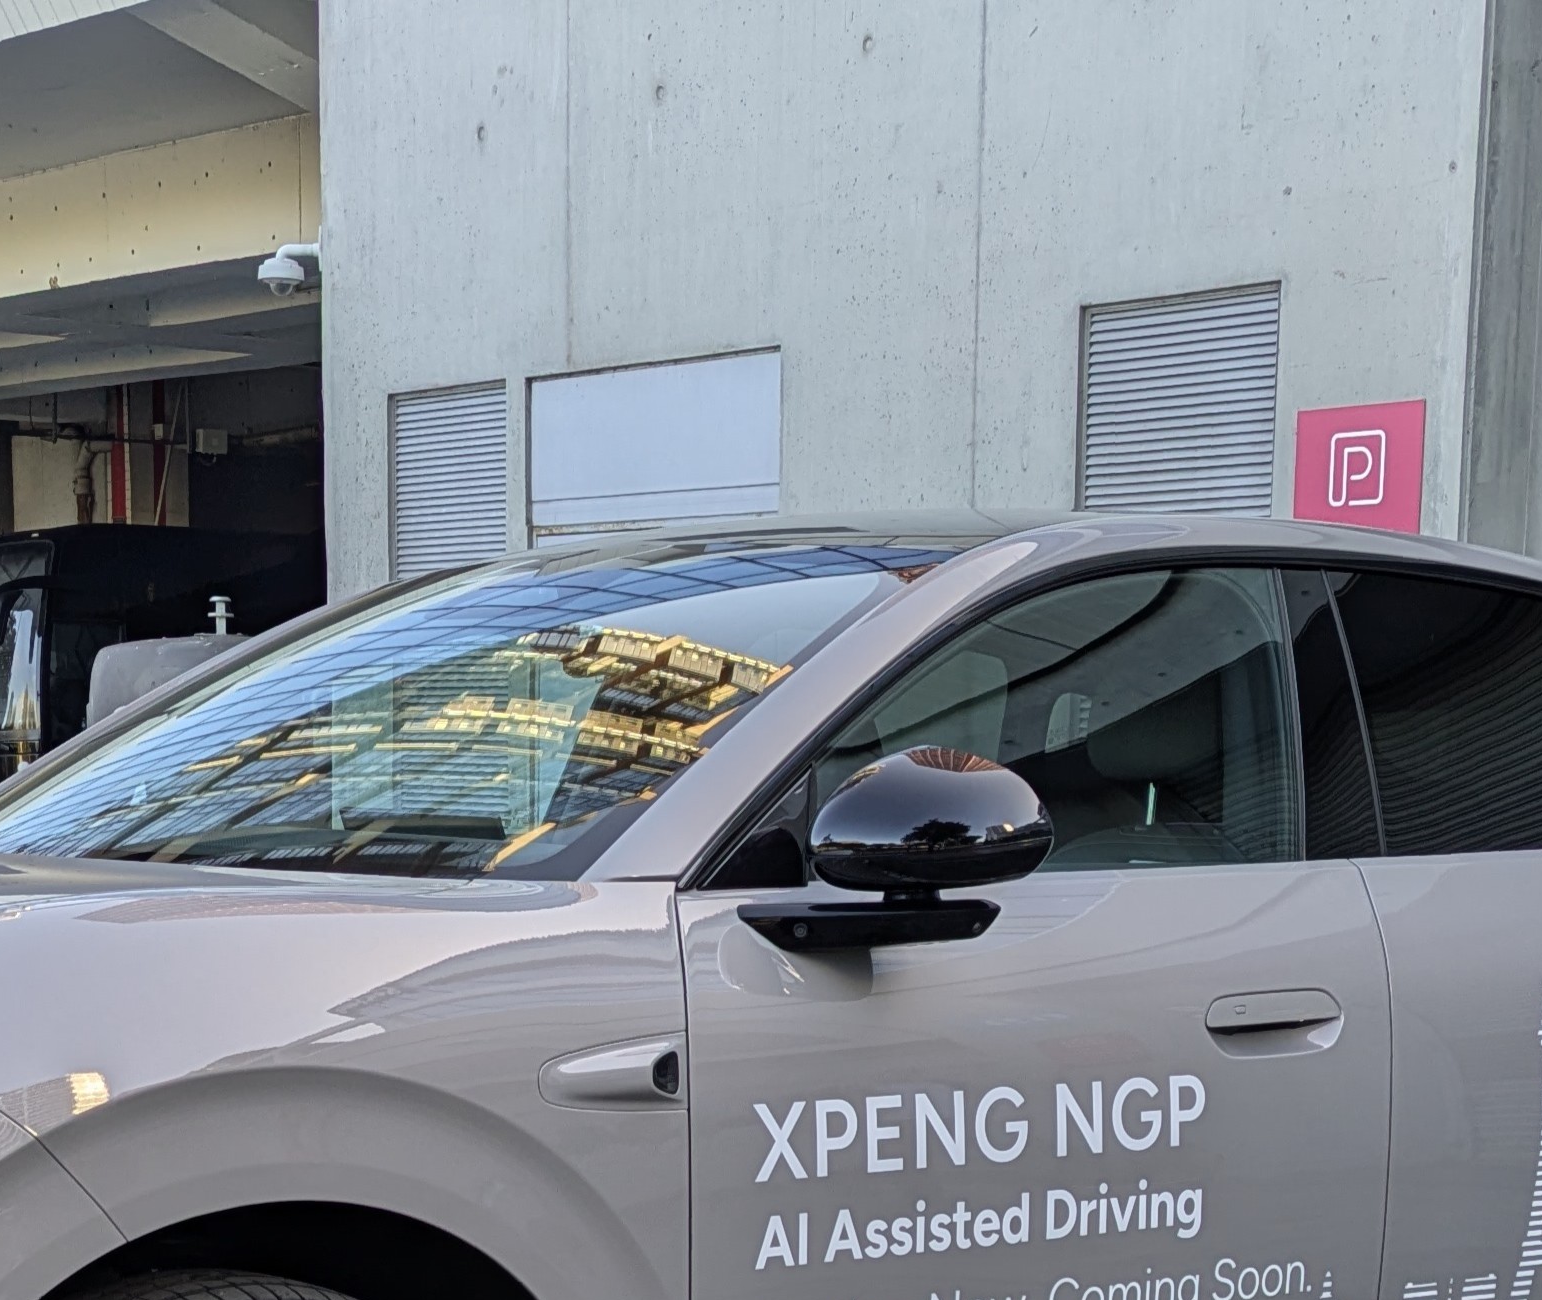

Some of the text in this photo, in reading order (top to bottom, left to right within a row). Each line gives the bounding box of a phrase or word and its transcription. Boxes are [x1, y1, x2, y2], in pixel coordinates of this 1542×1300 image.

[752, 1074, 1206, 1183] XPENG NGP
[754, 1179, 1203, 1271] AI Assisted Driving
